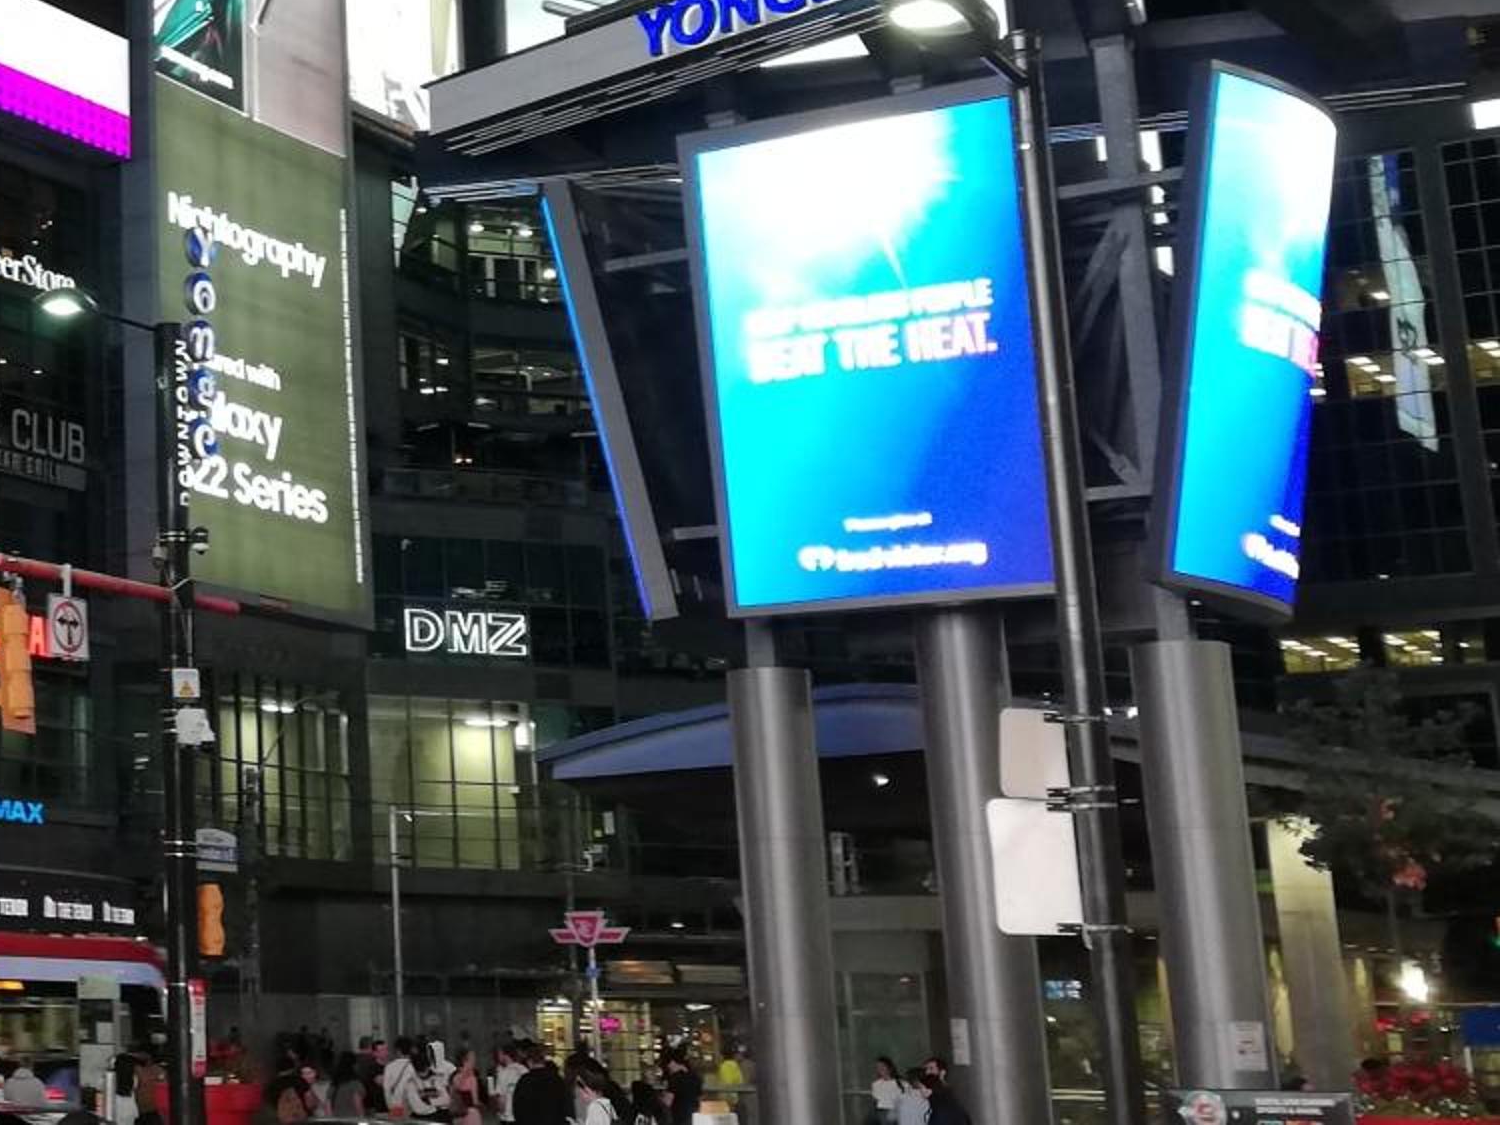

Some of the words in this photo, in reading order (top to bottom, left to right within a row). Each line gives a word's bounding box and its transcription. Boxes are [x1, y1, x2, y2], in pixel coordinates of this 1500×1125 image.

[833, 323, 902, 371] THE
[11, 408, 86, 464] CLUB
[210, 390, 283, 461] laxy
[233, 462, 329, 524] Series
[403, 607, 528, 657] DMZ
